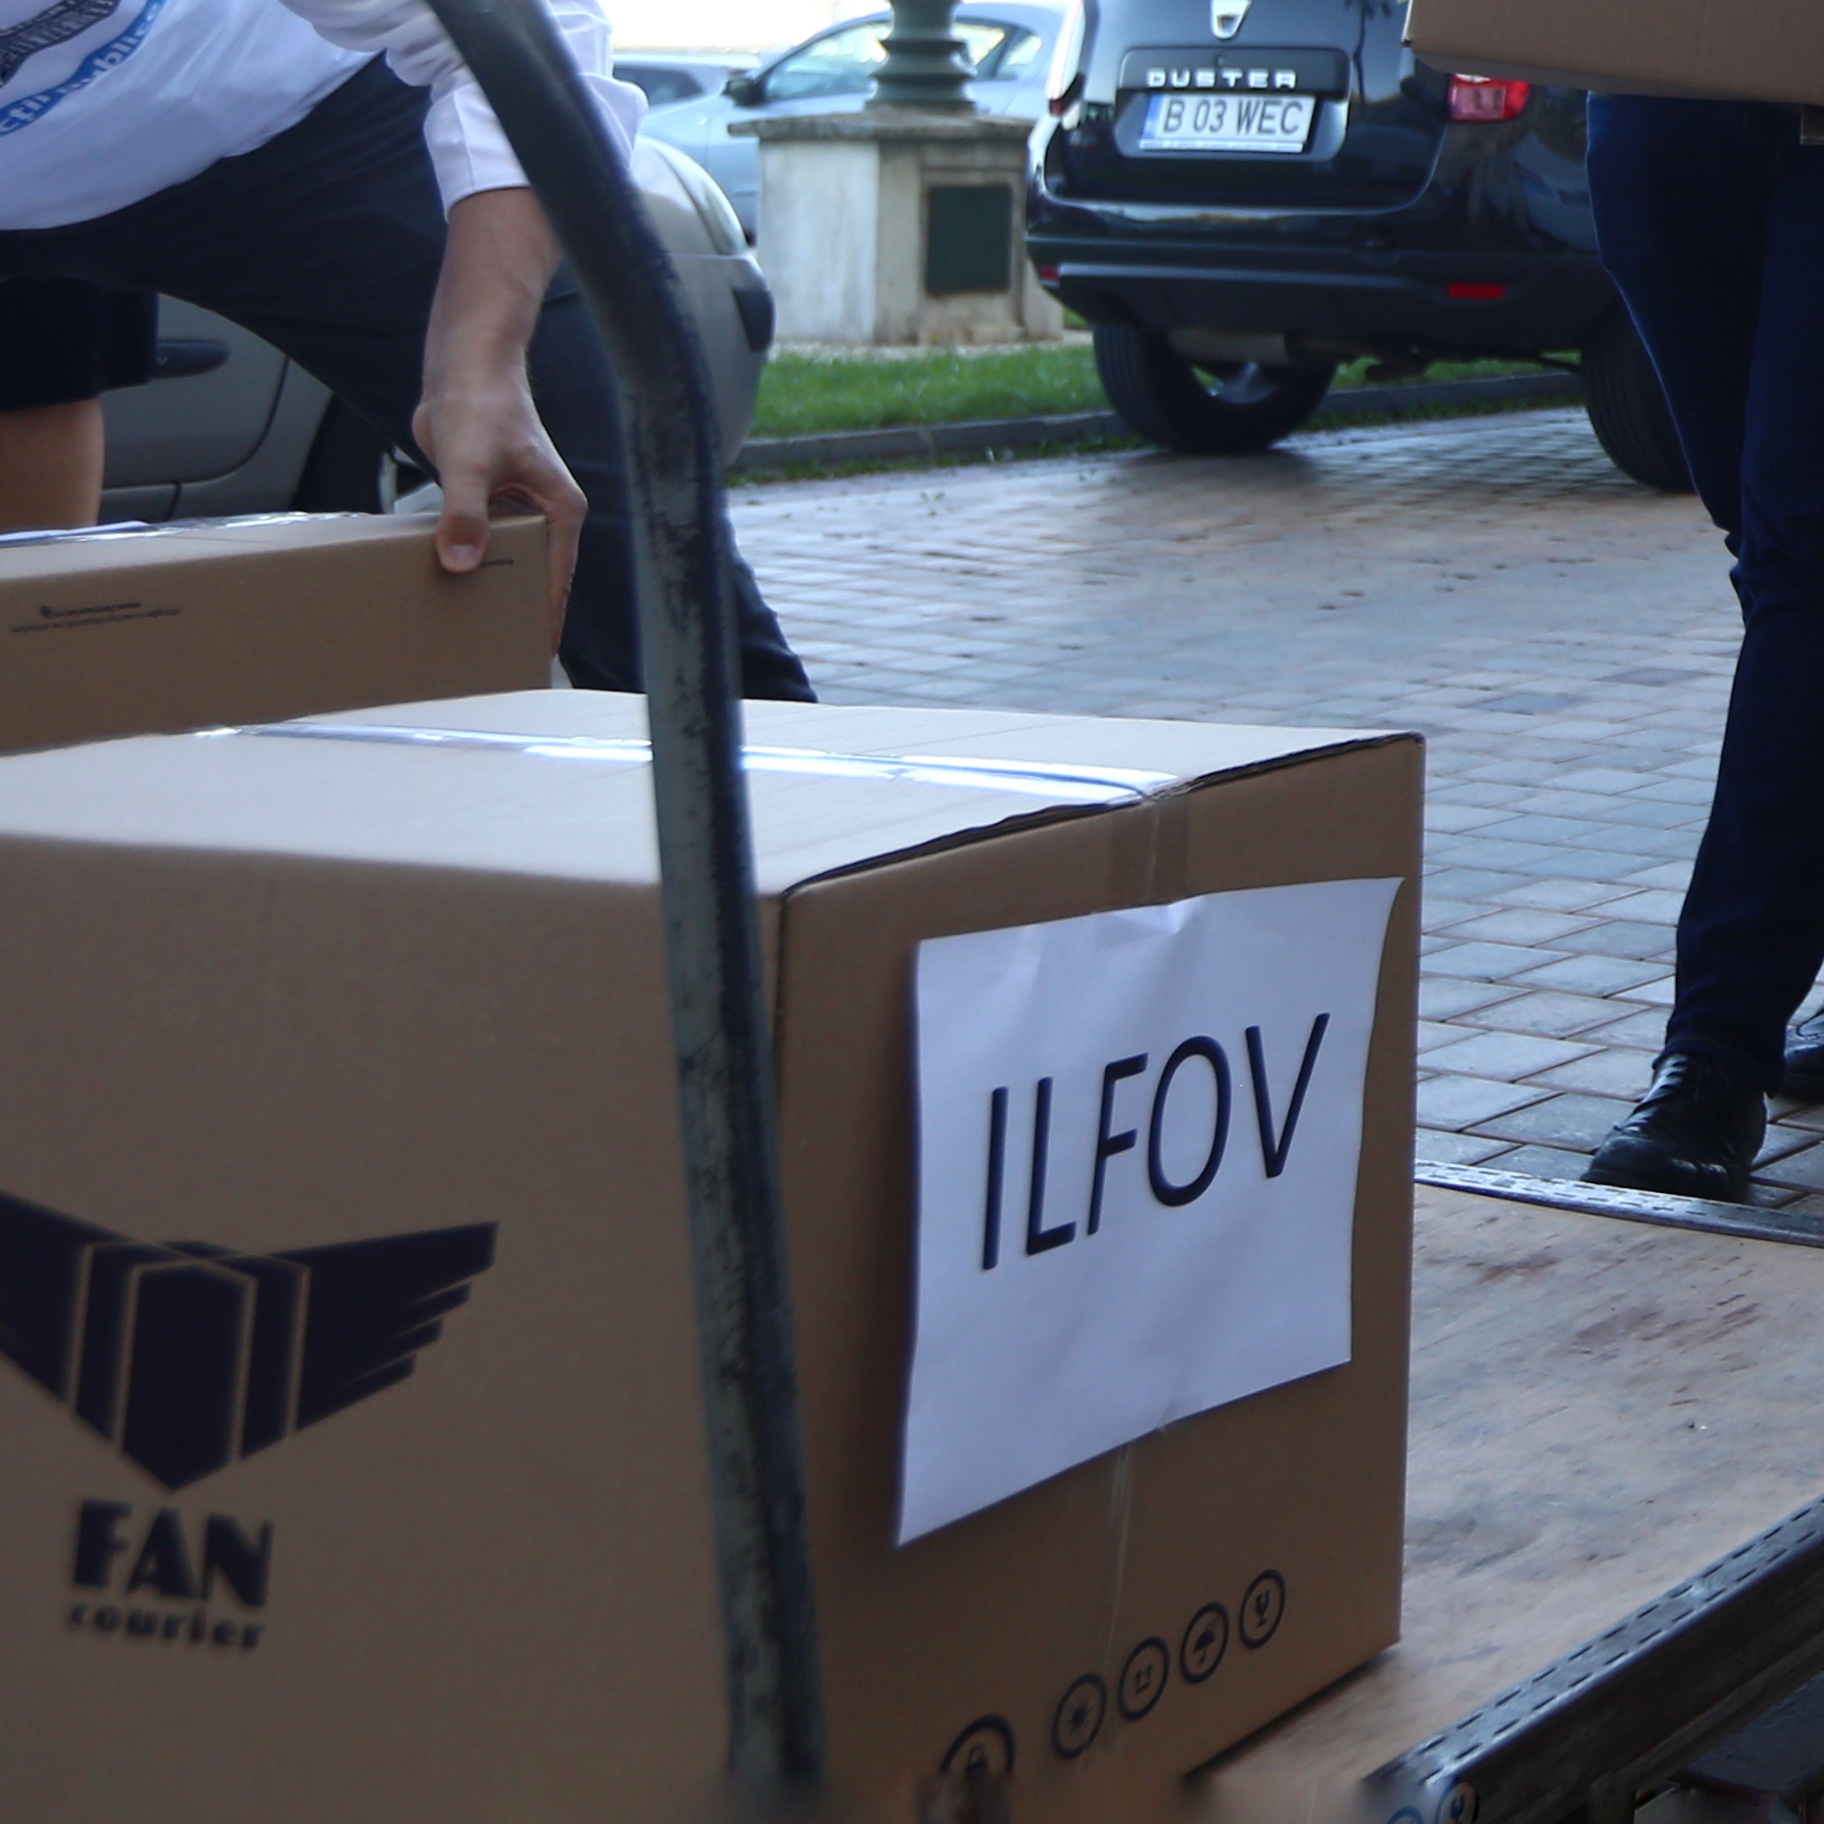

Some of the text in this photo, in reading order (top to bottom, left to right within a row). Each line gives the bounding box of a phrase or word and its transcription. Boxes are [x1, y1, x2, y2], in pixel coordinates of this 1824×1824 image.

[1147, 67, 1297, 89] DUSTER
[1164, 98, 1304, 135] B 03 WEC
[980, 1012, 1332, 1273] ILFOV
[73, 1498, 275, 1610] FAN
[66, 1602, 268, 1652] courier
